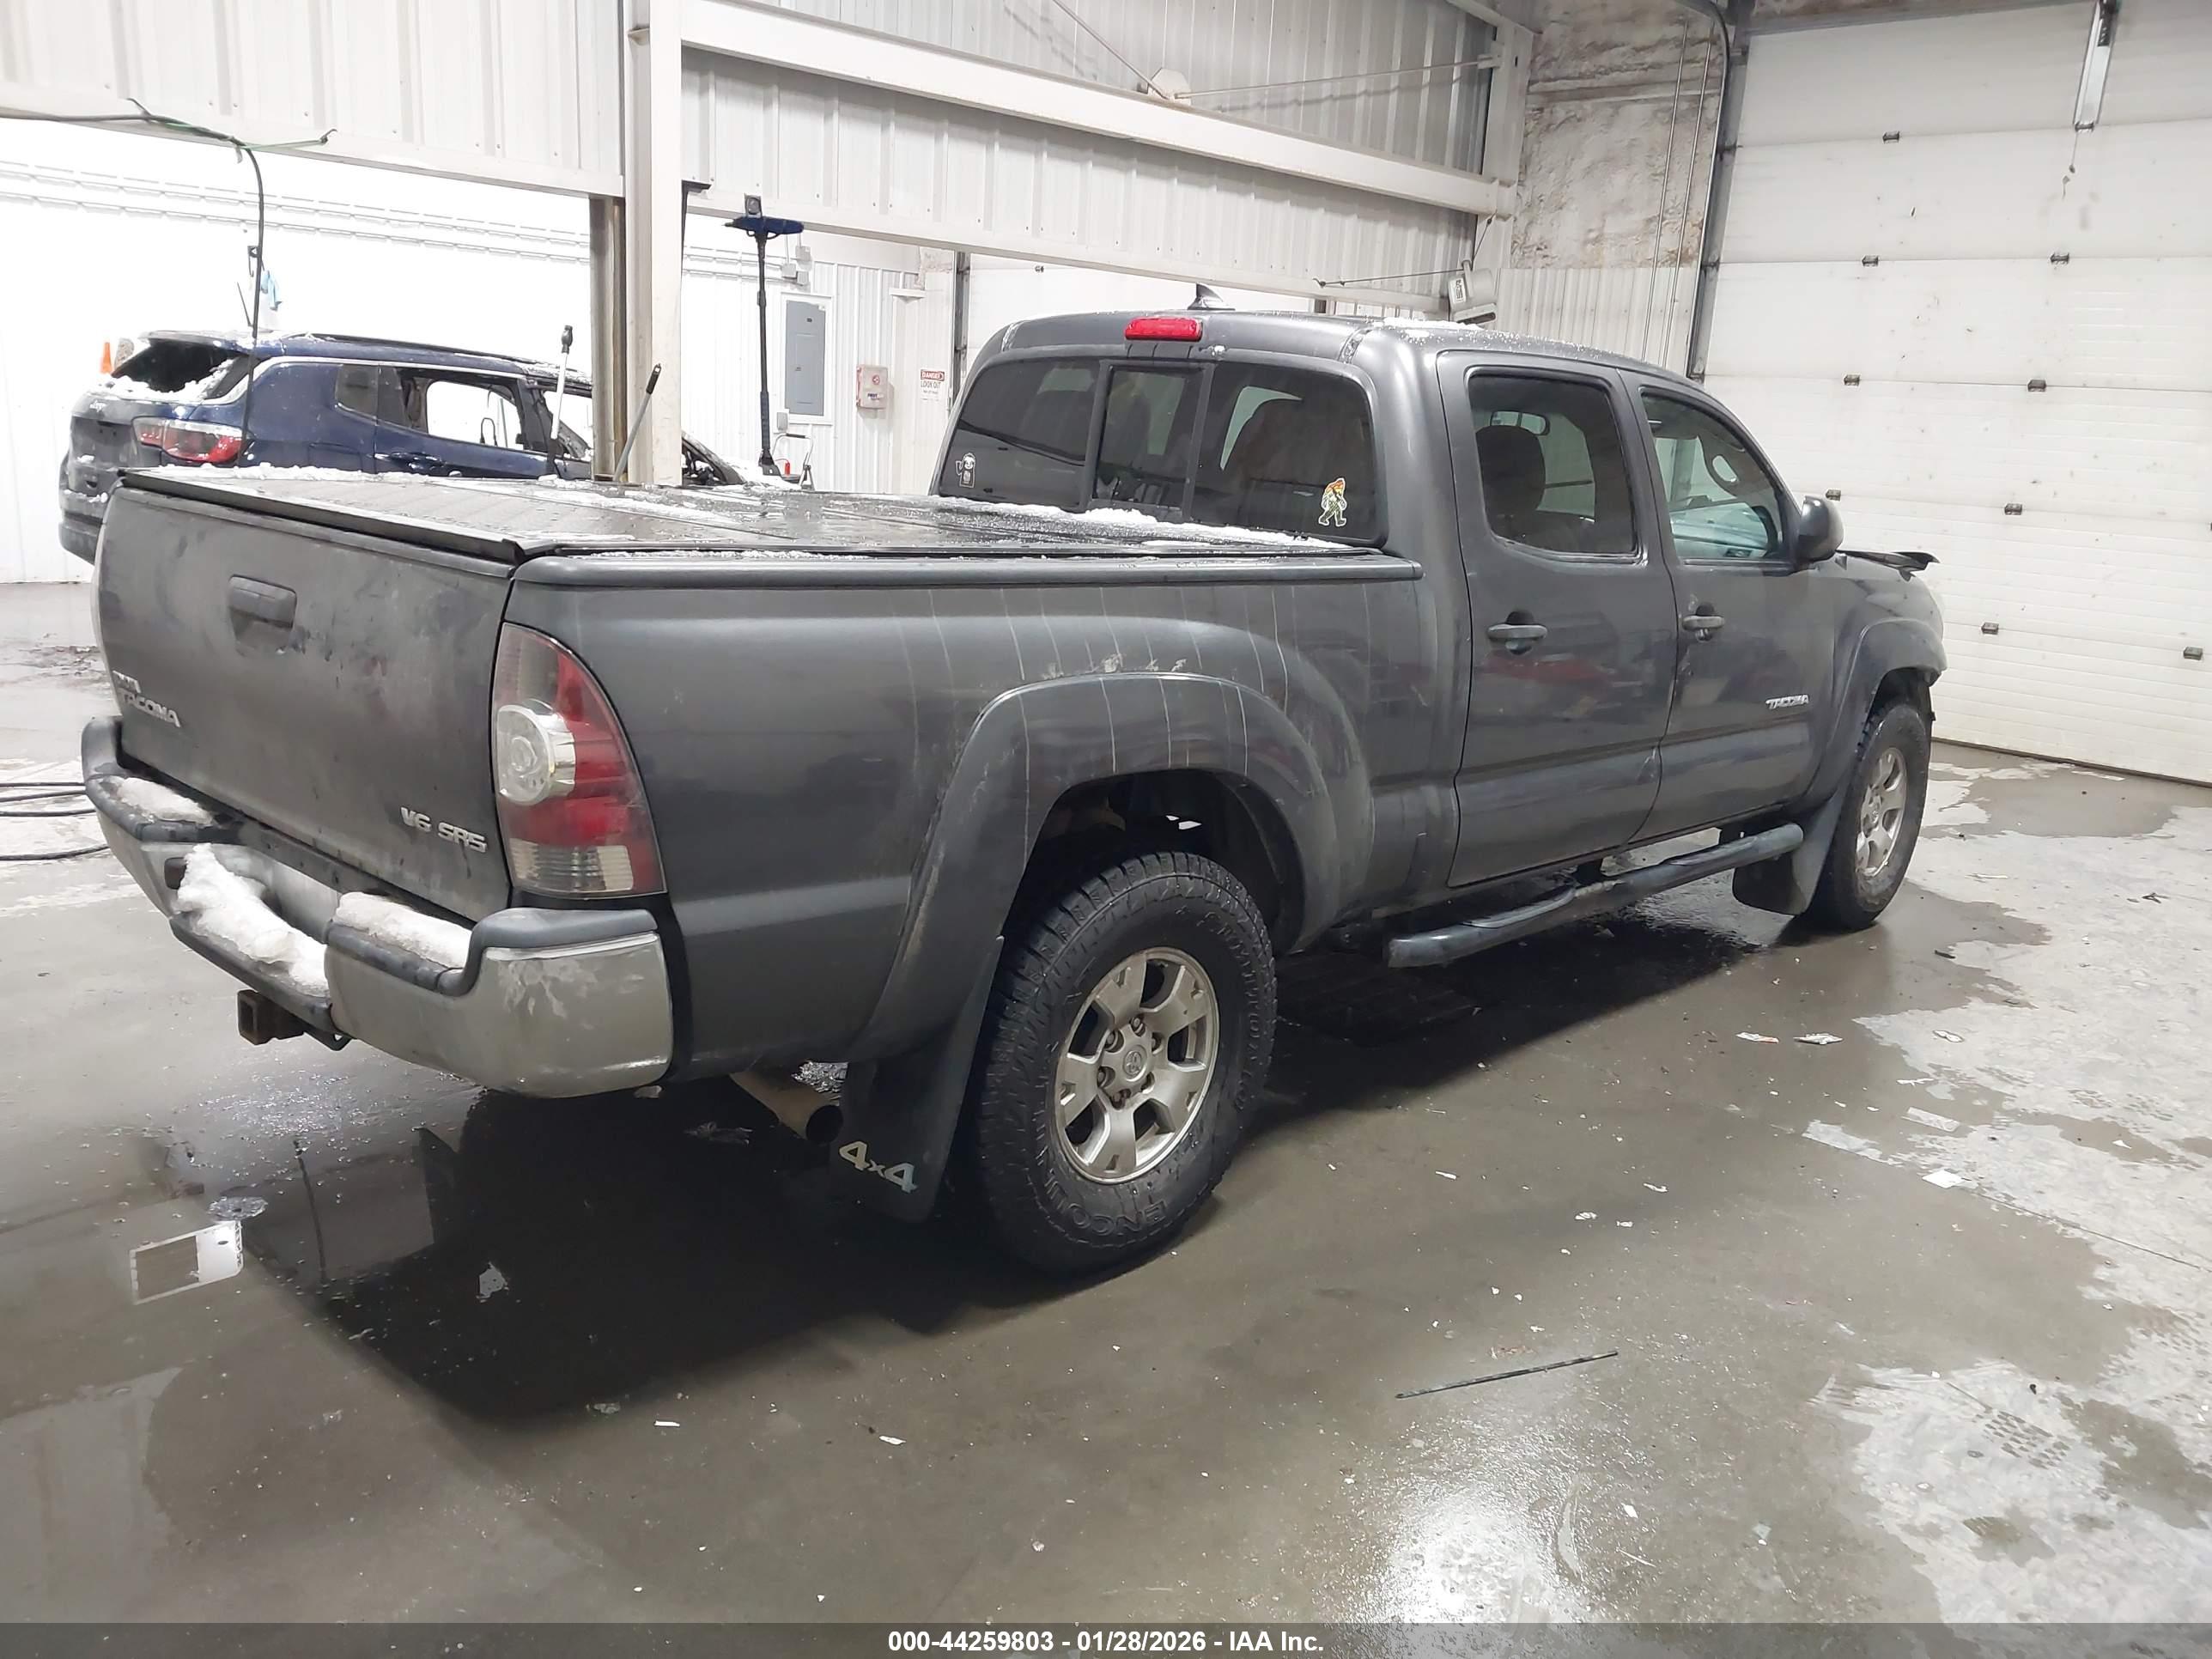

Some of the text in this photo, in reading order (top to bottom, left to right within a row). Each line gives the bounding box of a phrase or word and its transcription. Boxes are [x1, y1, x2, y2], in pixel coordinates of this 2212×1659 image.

[1765, 695, 1809, 709] TACOMA
[400, 806, 487, 853] V6 SR5
[839, 1141, 918, 1194] 4x4
